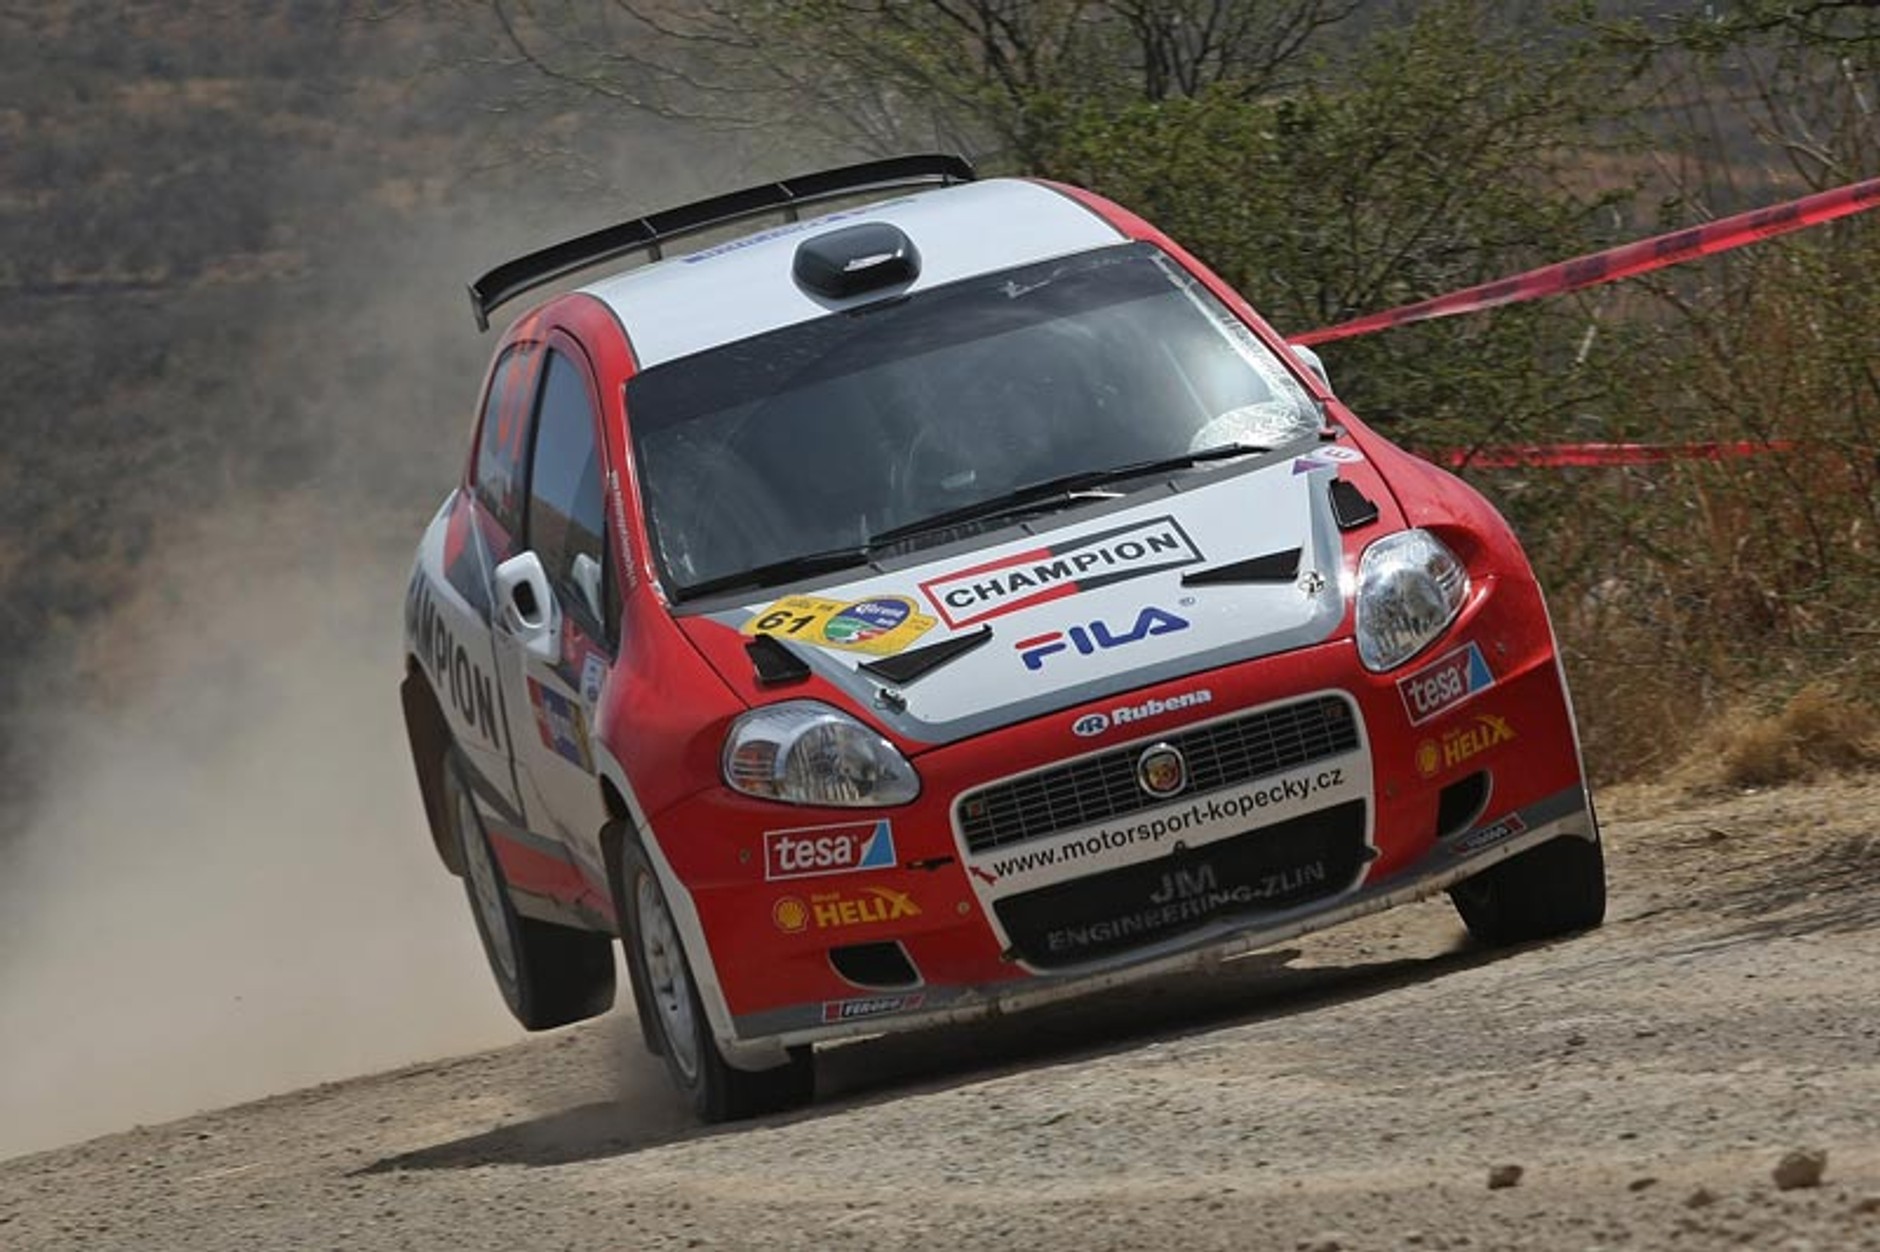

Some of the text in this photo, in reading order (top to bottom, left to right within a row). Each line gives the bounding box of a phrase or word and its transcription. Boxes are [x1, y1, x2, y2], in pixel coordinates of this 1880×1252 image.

[945, 532, 1179, 608] CHAMPION
[756, 611, 815, 634] 61
[1014, 606, 1190, 671] FILA
[1111, 689, 1212, 725] Rubena
[1408, 666, 1462, 712] tesa
[1443, 715, 1517, 768] HELIX
[993, 768, 1344, 879] www.motorsport-kopecky.cz
[775, 836, 852, 871] tesa
[1149, 863, 1216, 904] JM
[812, 885, 922, 928] HELIX
